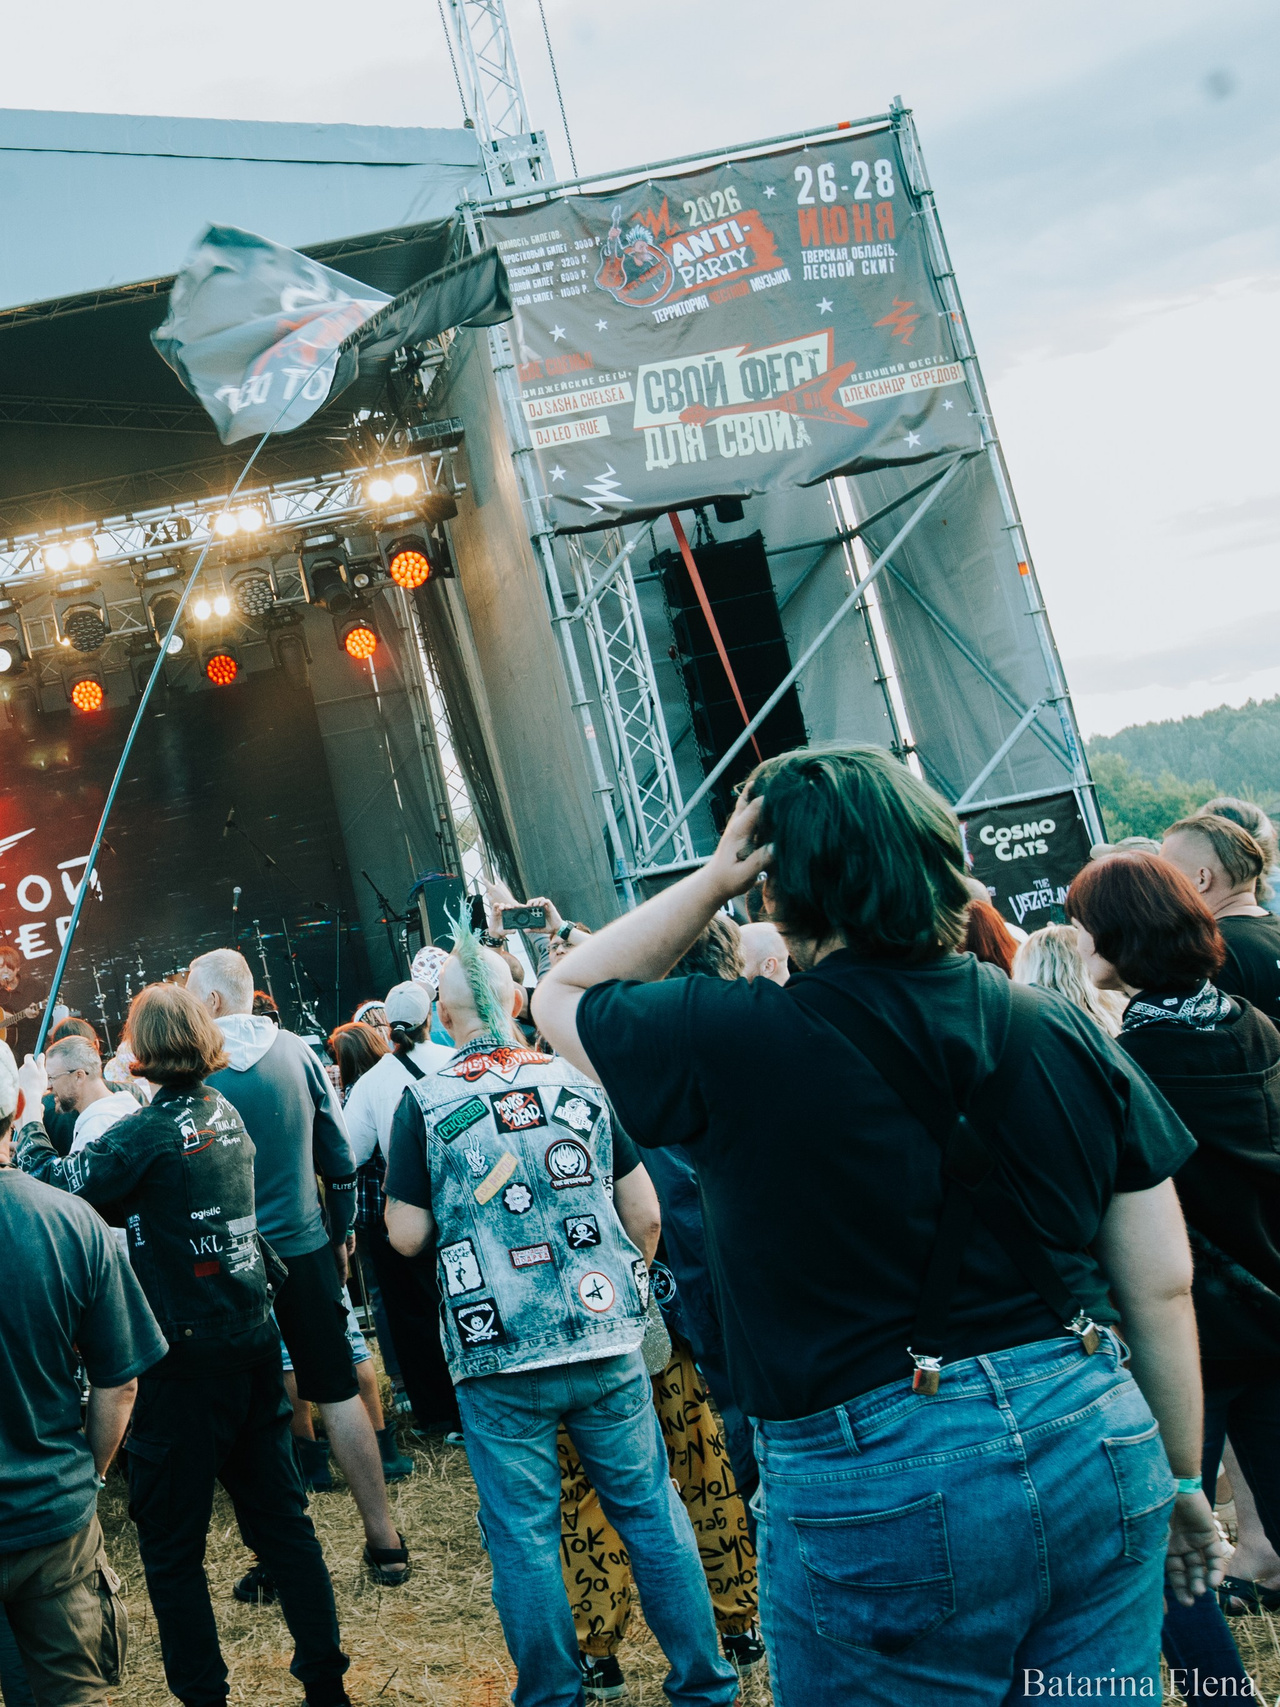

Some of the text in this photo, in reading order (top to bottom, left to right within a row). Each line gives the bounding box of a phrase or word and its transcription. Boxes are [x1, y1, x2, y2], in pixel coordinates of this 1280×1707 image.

[794, 159, 895, 205] 26-28
[683, 185, 742, 227] 2026
[797, 201, 896, 248] ИЮНЯ
[496, 237, 530, 251] ТОИМОСТЬ
[672, 219, 751, 268] ANTI-
[801, 247, 848, 264] ТВЕРСКАЯ
[678, 246, 749, 289] PARTY
[803, 258, 895, 281] ЛЕСНОЙ СКИТ
[652, 295, 709, 323] ТЕРРИТОРИЯ
[749, 268, 791, 293] МУЗЫКИ
[522, 377, 595, 398] ДИДЖЕЙСКИЕ
[643, 348, 820, 414] СВОЙ ФЕСТ
[843, 364, 961, 403] АЛЕКСАНДР СЕРЕДОВ!
[851, 362, 905, 382] ВЕДУЩИЙ
[528, 387, 626, 418] DJ SASHA CHELSEA
[536, 419, 600, 445] DJ LEO TRUE
[643, 422, 708, 471] ДЛЯ
[1032, 877, 1050, 890] THE
[1008, 884, 1070, 924] VAZELIN
[332, 1182, 352, 1190] ELITE
